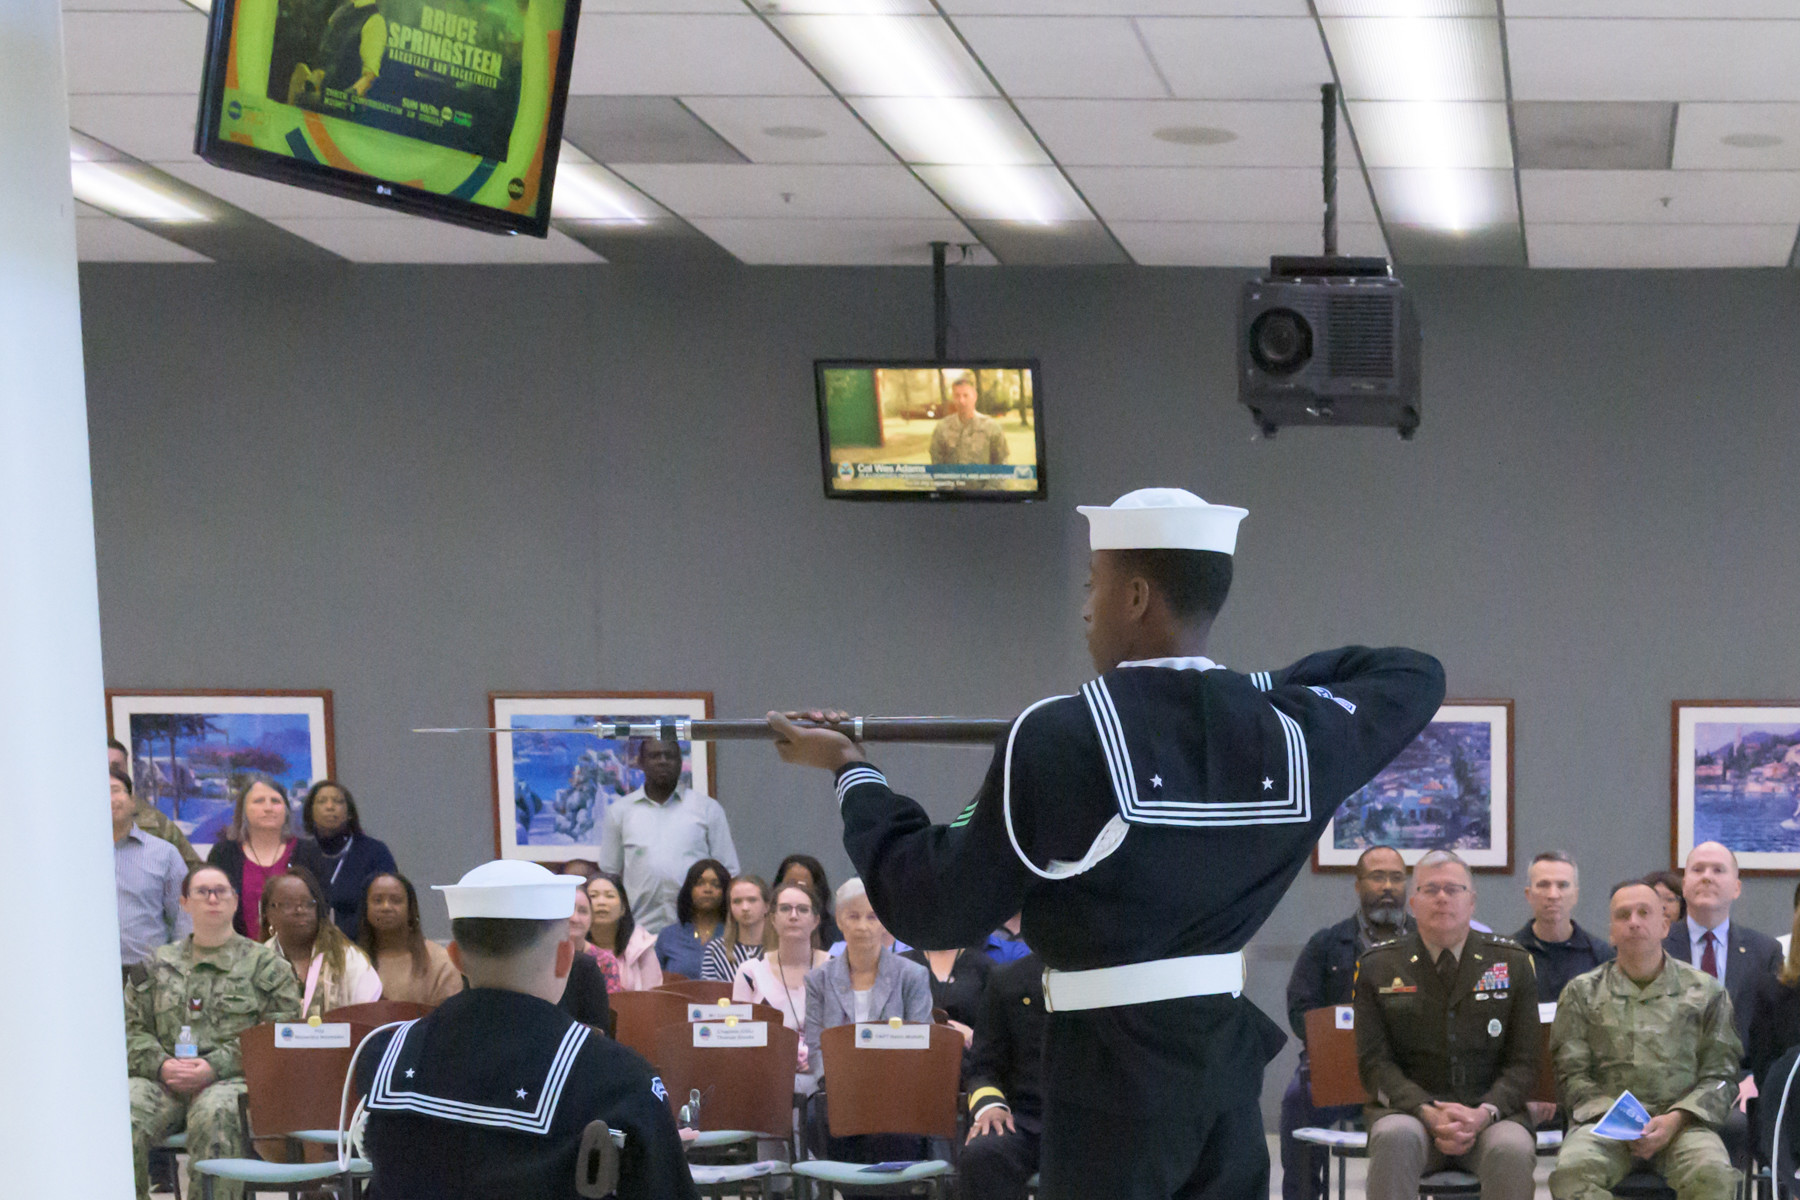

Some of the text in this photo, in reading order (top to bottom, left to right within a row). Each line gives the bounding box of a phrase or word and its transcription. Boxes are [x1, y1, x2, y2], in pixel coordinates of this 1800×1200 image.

[421, 5, 478, 44] BRUCE
[388, 22, 503, 79] SPRINGSTEEN
[432, 61, 448, 75] AND
